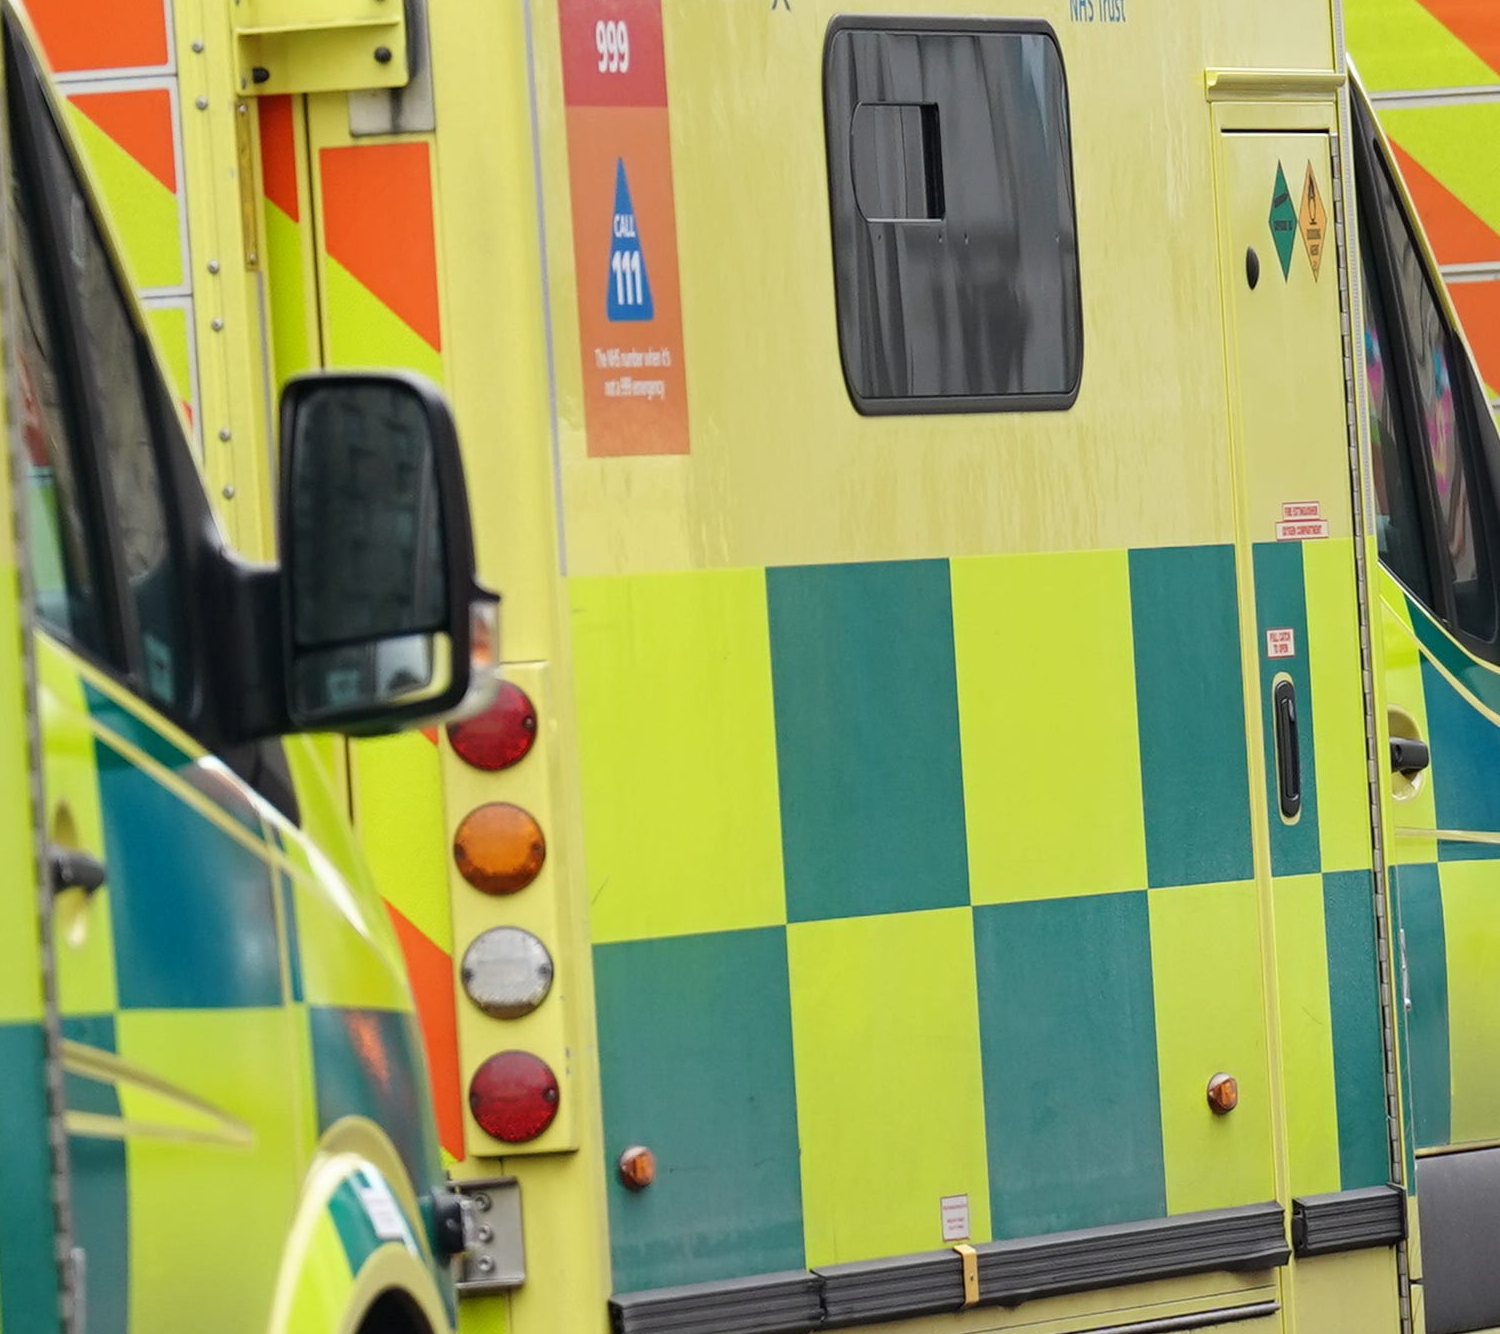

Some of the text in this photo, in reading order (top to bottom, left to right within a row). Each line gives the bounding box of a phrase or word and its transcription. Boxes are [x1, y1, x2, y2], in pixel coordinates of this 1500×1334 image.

[596, 20, 629, 73] 999
[613, 213, 636, 238] CALL
[612, 250, 643, 306] 111
